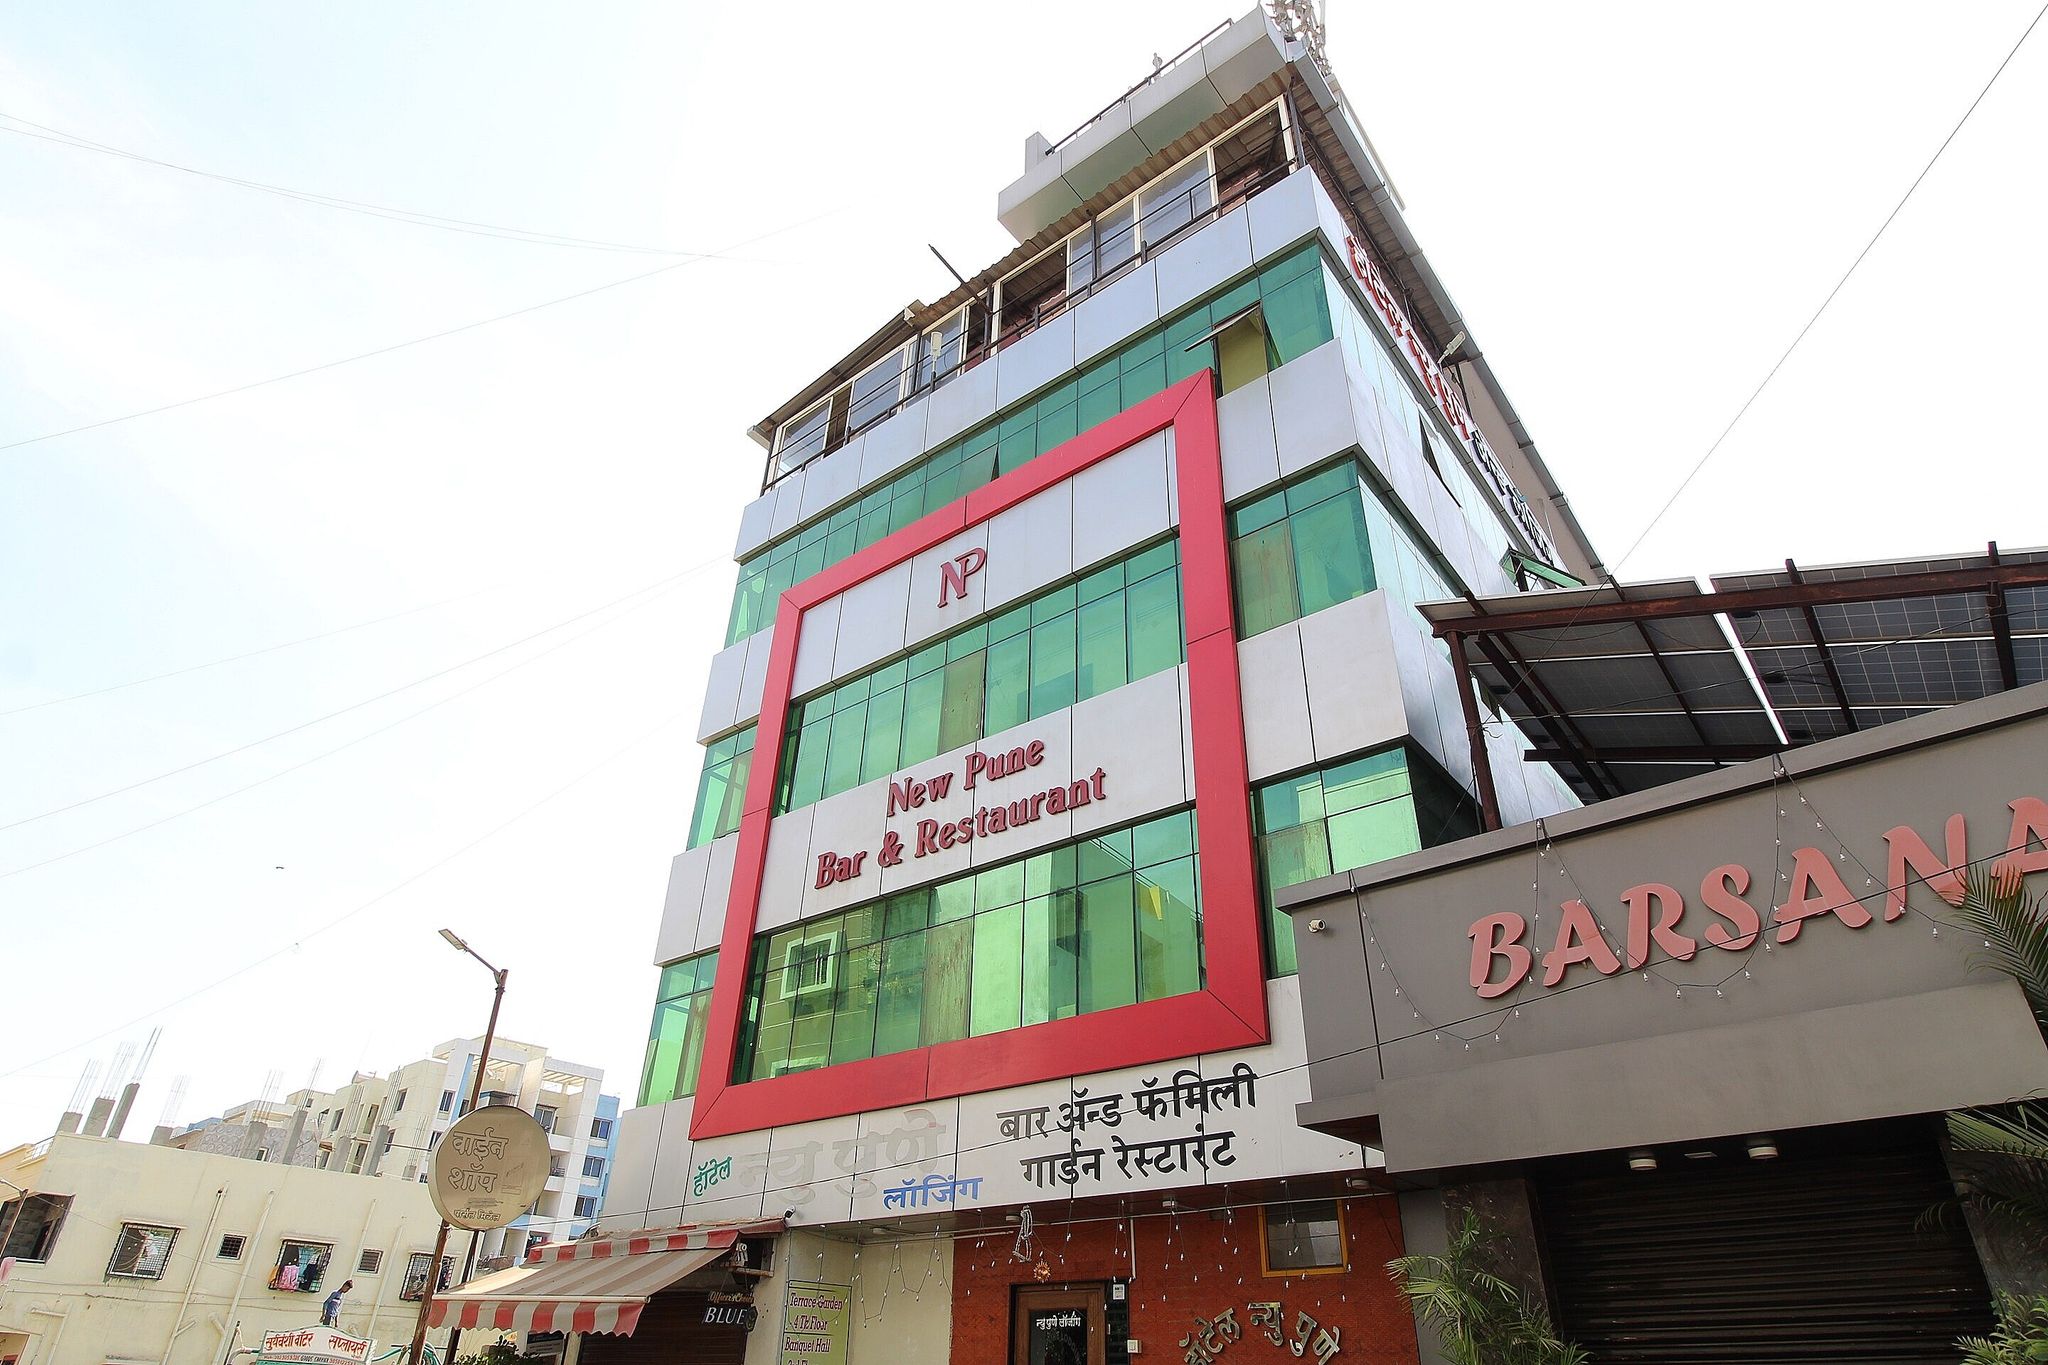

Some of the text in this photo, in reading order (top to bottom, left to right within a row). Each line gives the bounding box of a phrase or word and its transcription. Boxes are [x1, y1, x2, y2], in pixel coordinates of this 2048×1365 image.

[937, 547, 986, 608] NP
[887, 739, 1045, 817] New Pune
[814, 767, 1106, 889] Bar & Restaurant
[996, 1106, 1050, 1139] बार
[1131, 1062, 1258, 1121] फॅमिली
[453, 1127, 509, 1161] वाईन
[1020, 1123, 1237, 1188] गार्डन रेस्टारंट
[448, 1163, 498, 1193] शॉप
[693, 1156, 733, 1197] हॉटेल
[883, 1174, 984, 1210] लॉजिंग
[704, 1306, 747, 1325] BLUE
[790, 1293, 843, 1310] Terrace Garden
[794, 1315, 799, 1328] 4
[810, 1316, 828, 1330] Floor
[785, 1337, 831, 1355] Banquet Hall
